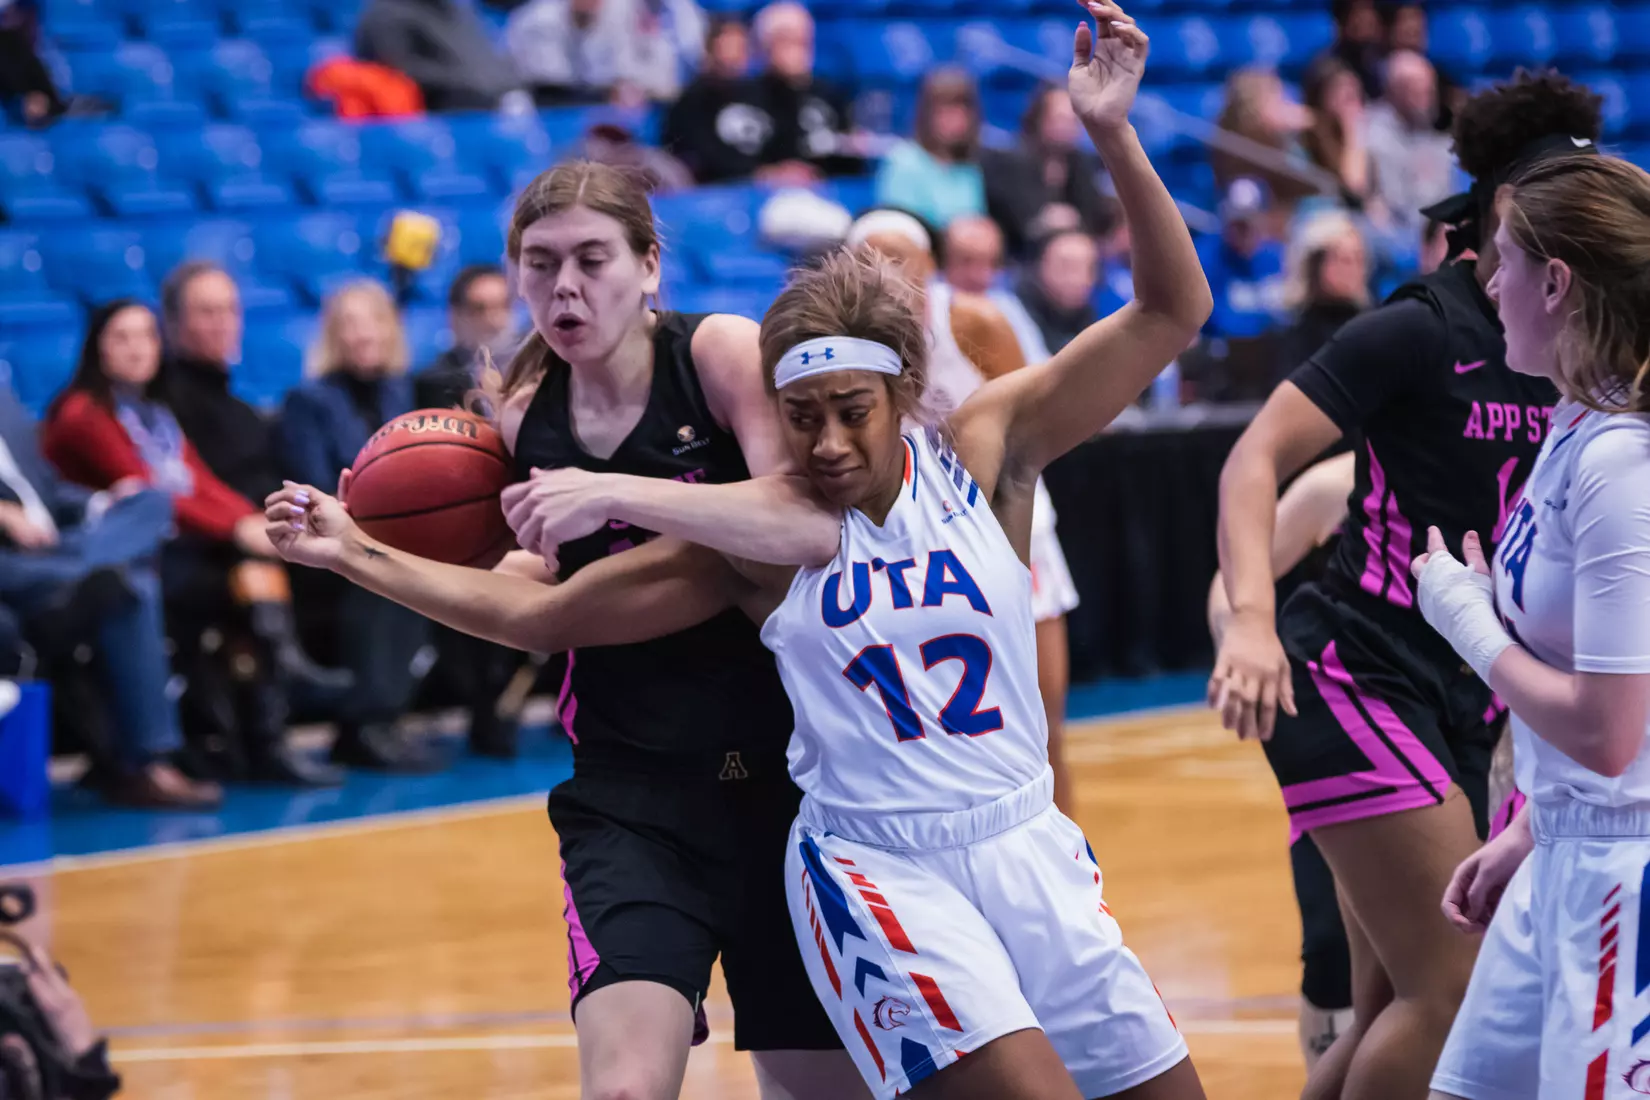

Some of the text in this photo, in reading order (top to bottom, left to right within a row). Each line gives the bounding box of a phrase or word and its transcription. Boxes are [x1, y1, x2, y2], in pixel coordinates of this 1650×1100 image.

[1463, 400, 1521, 441] APP
[821, 549, 994, 628] UTA
[842, 633, 1005, 742] 12
[719, 751, 748, 780] A
